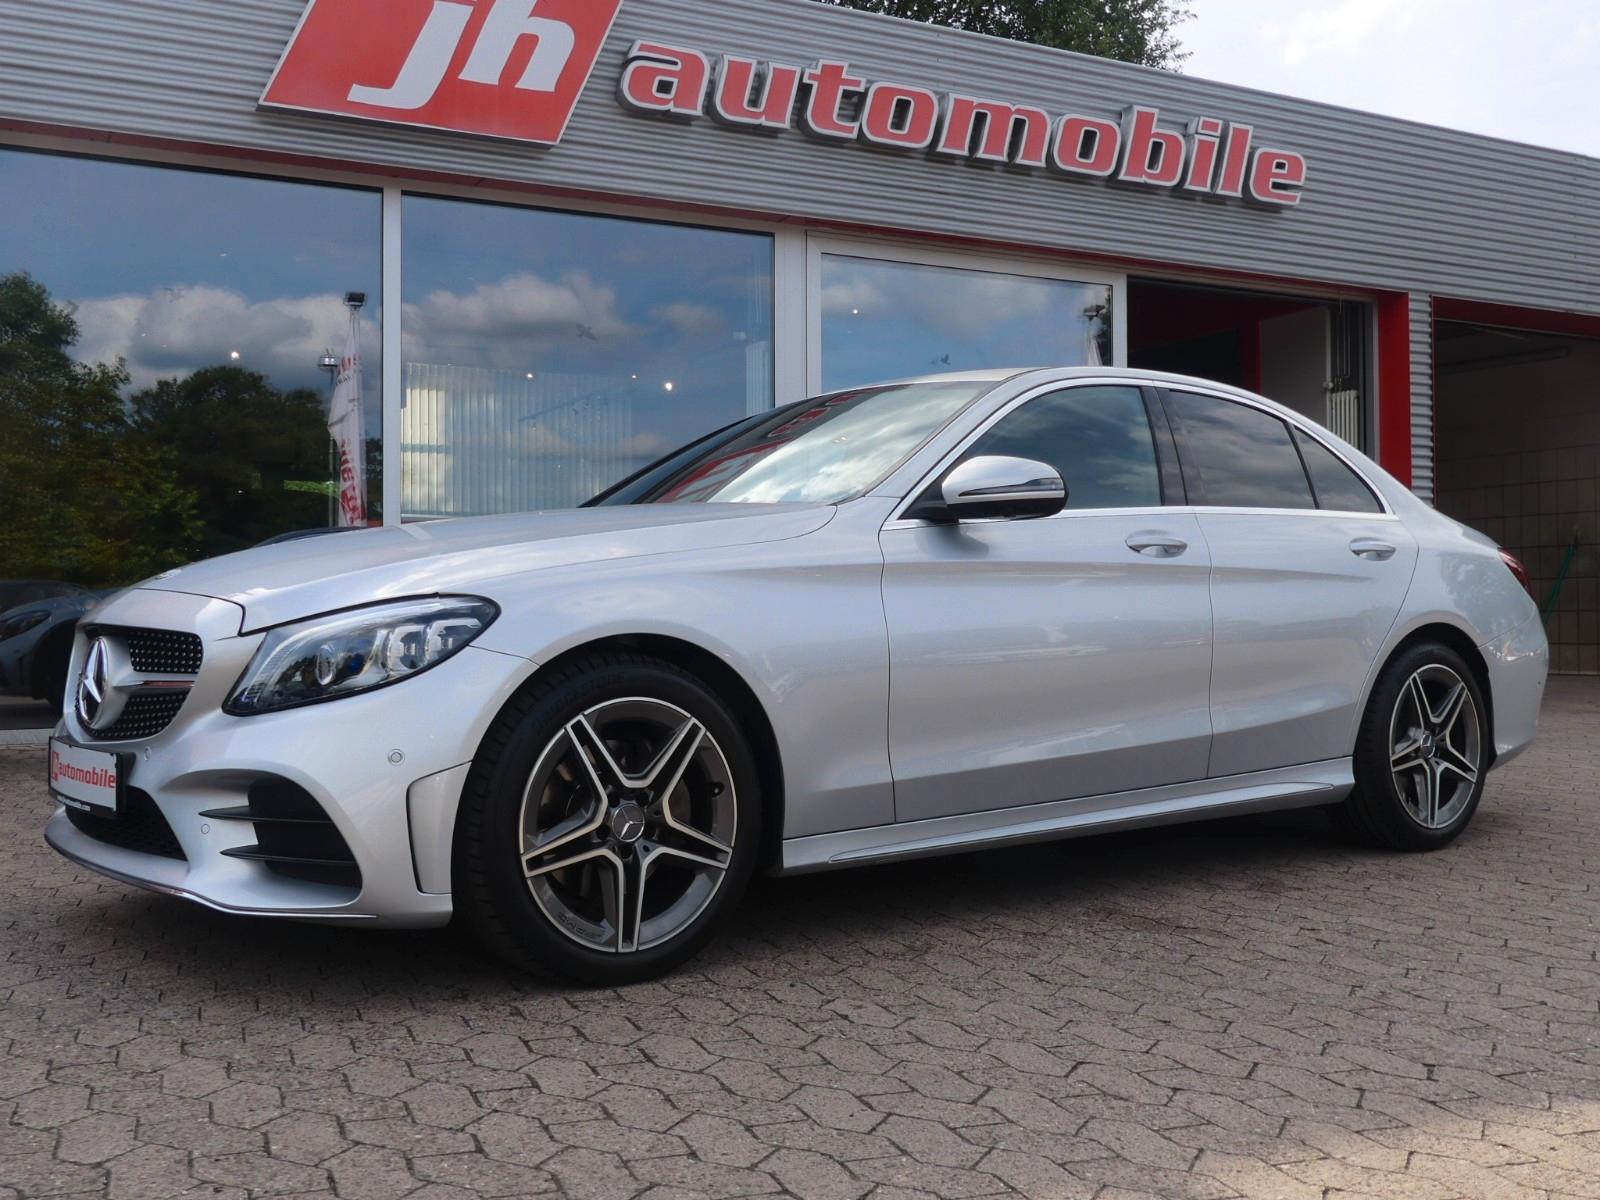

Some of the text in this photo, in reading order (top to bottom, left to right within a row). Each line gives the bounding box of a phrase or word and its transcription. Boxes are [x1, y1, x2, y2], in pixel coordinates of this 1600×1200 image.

[347, 0, 1306, 205] jh automobile
[58, 763, 116, 788] automobile
